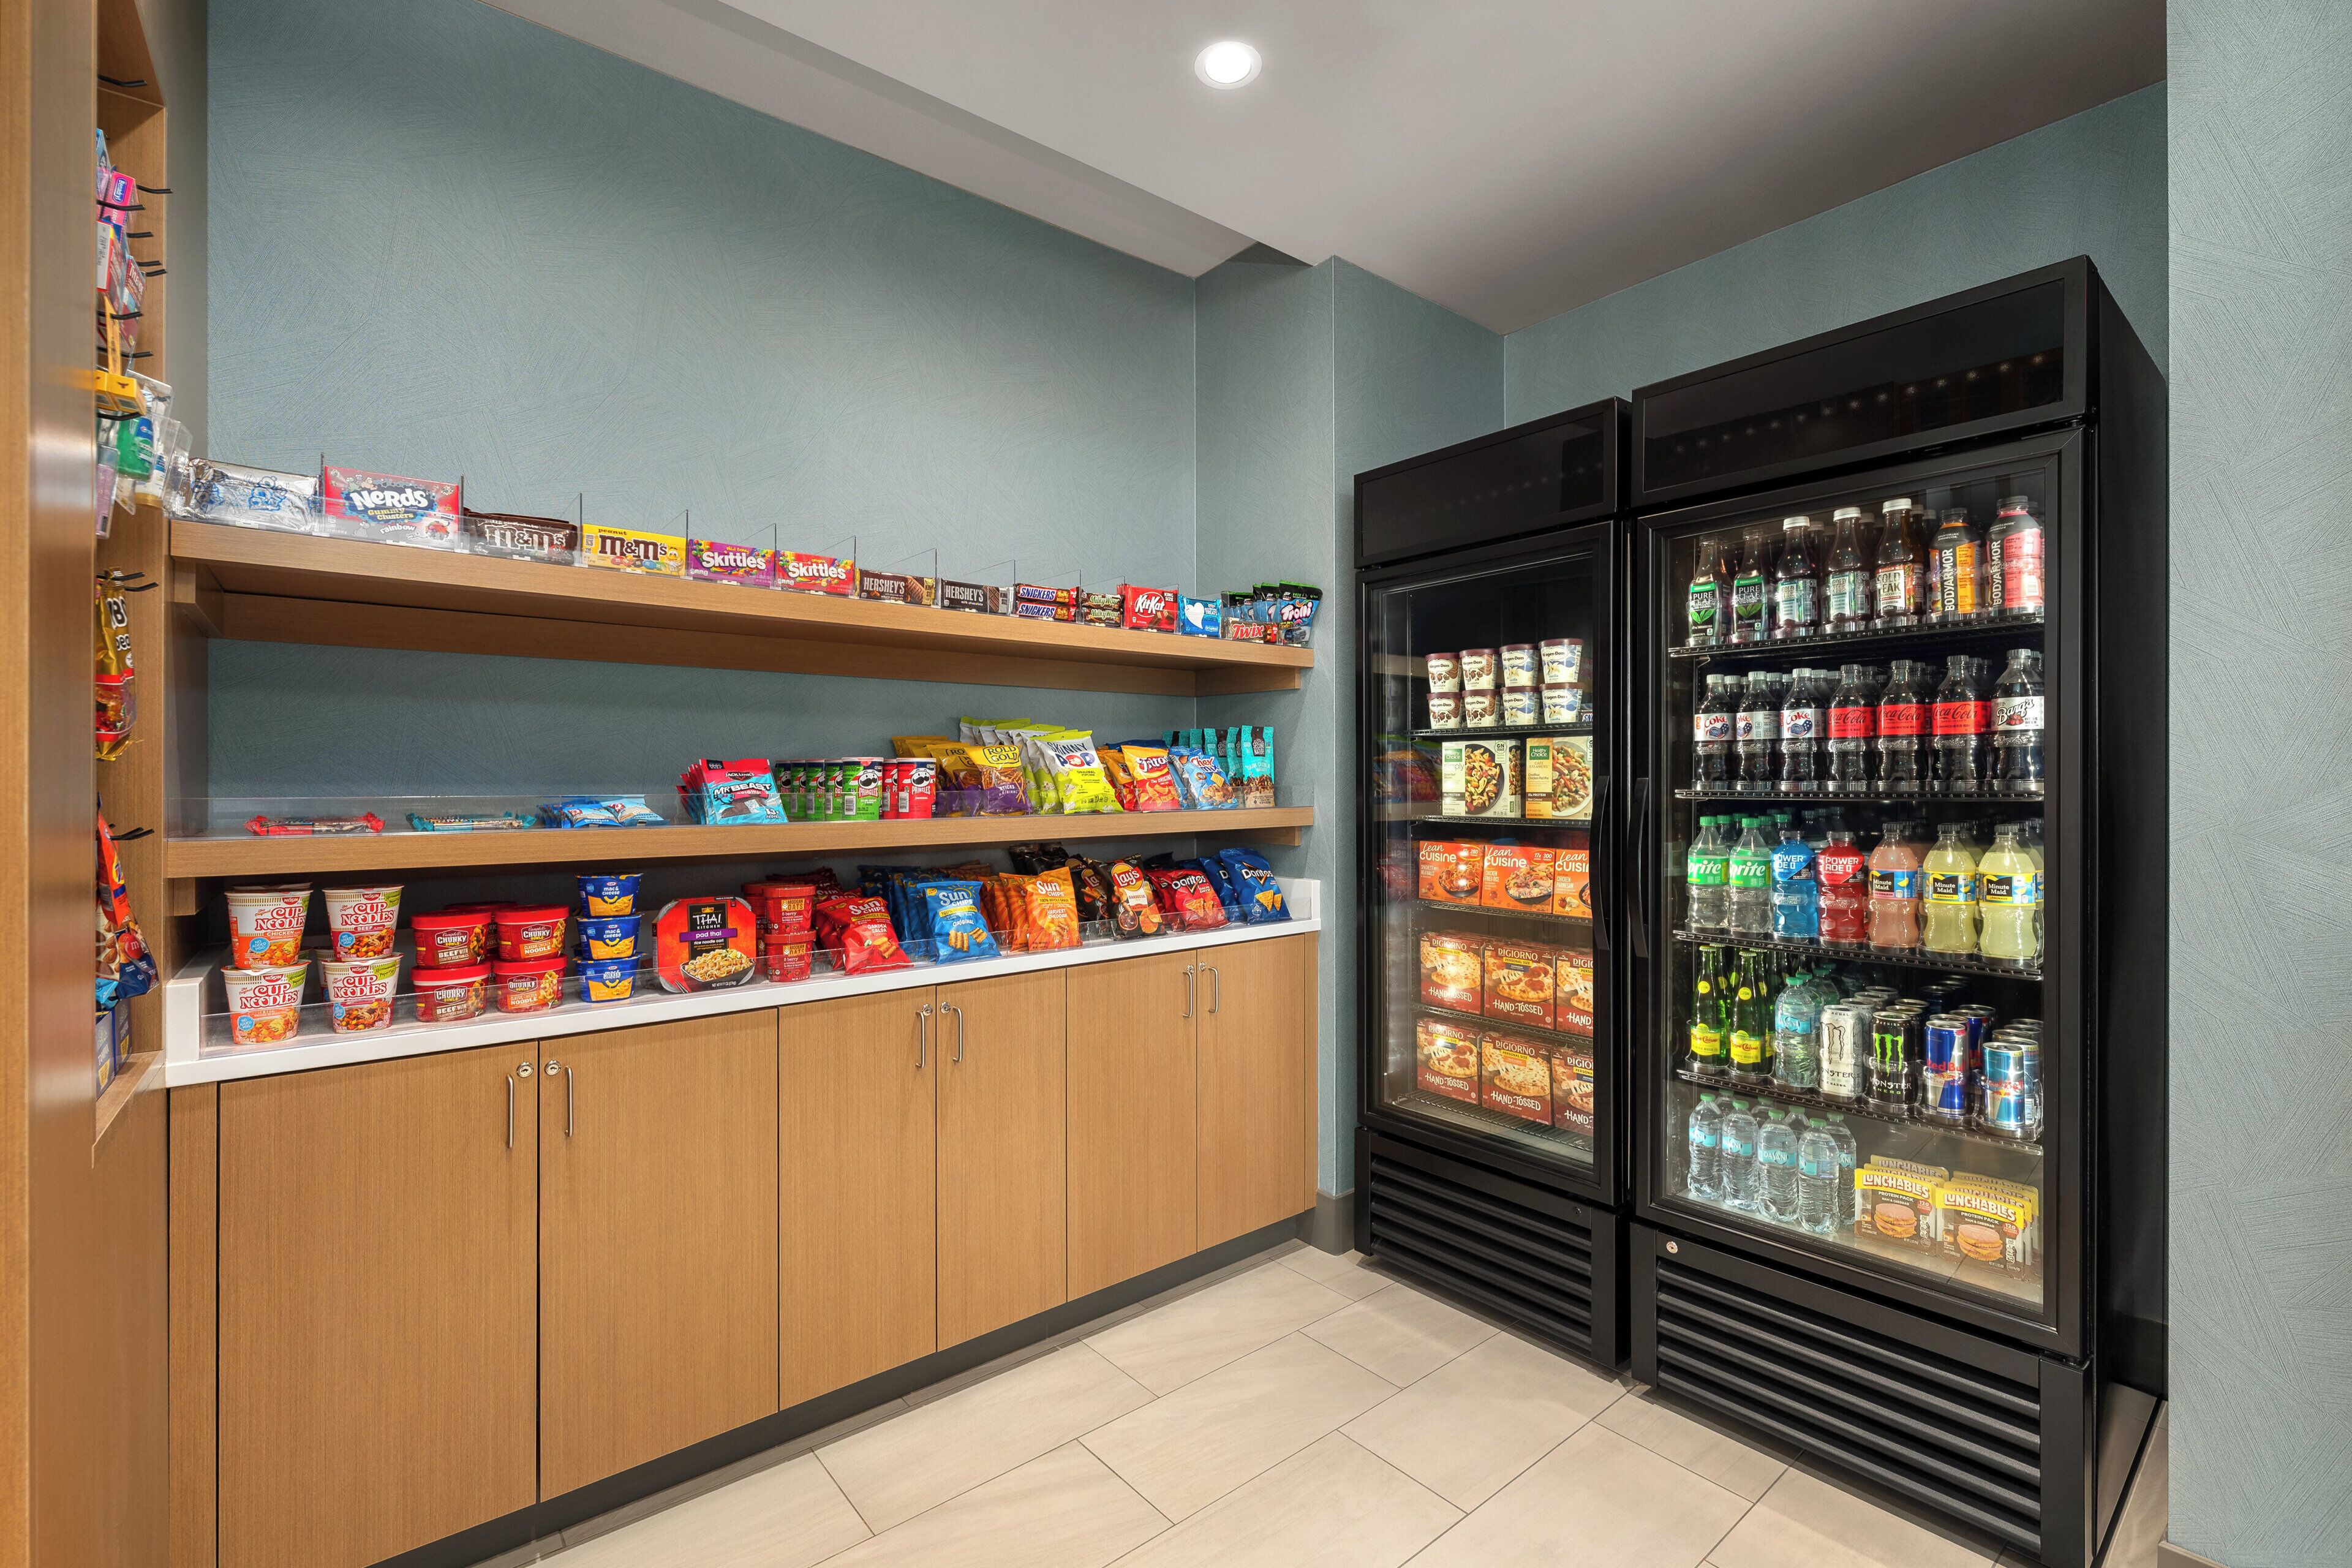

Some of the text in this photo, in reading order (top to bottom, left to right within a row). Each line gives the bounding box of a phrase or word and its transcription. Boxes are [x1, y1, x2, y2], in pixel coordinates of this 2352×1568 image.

[379, 524, 417, 535] rainbow
[702, 551, 767, 570] Skittles
[788, 562, 846, 579] Skittles
[1992, 540, 2002, 606] BODYARMOR
[863, 577, 905, 594] HERSHEY'S
[1942, 548, 1955, 611] BODYARMOR
[946, 586, 984, 602] HERSHEY'S
[1019, 587, 1057, 600] SNICKERS
[1018, 604, 1056, 617] SNICKERS
[1281, 601, 1313, 621] Trolli
[1878, 706, 1922, 722] Coca-Cola
[1933, 703, 1978, 721] Coca-Cola
[1997, 698, 2035, 725] Barq's
[991, 753, 1017, 762] GOLD
[1055, 752, 1095, 767] POP
[1189, 756, 1215, 766] Chex
[859, 788, 878, 797] PRINGLES
[911, 786, 930, 794] PRINGLES
[1422, 842, 1444, 853] Lean
[1487, 847, 1513, 859] Lean
[1559, 851, 1588, 864] Lean
[1114, 869, 1140, 888] Lay's
[1241, 869, 1273, 880] Doritos
[1036, 880, 1060, 895] Sun
[939, 891, 969, 906] Sun
[271, 907, 304, 919] CUP
[353, 902, 388, 914] CUP
[849, 900, 880, 914] Sun
[255, 916, 306, 931] NOODLES
[341, 910, 394, 925] NOODLES
[692, 913, 722, 925] THAI
[437, 935, 467, 944] CHUNKY
[523, 929, 550, 938] CHUNKY
[524, 945, 551, 954] NOODLE
[1432, 938, 1467, 951] DIGIORNO
[1498, 948, 1538, 961] DIGIORNO
[342, 974, 377, 987] CUP
[253, 982, 291, 997] CUP
[333, 982, 386, 998] NOODLES
[240, 990, 298, 1009] NOODLES
[437, 1006, 456, 1014] BEEF
[1492, 999, 1544, 1016] HAND-TOSSED
[1428, 1025, 1464, 1040] DIGIORNO
[1496, 1040, 1536, 1056] DIGIORNO
[1425, 1072, 1469, 1091] HAND-TOSSED
[1490, 1090, 1541, 1111] HAND-TOSSED
[1863, 1174, 1930, 1199] LUNCHABLES
[1944, 1193, 2016, 1222] LUNCHABLES
[1961, 1212, 1999, 1225] PROTEIN PACK
